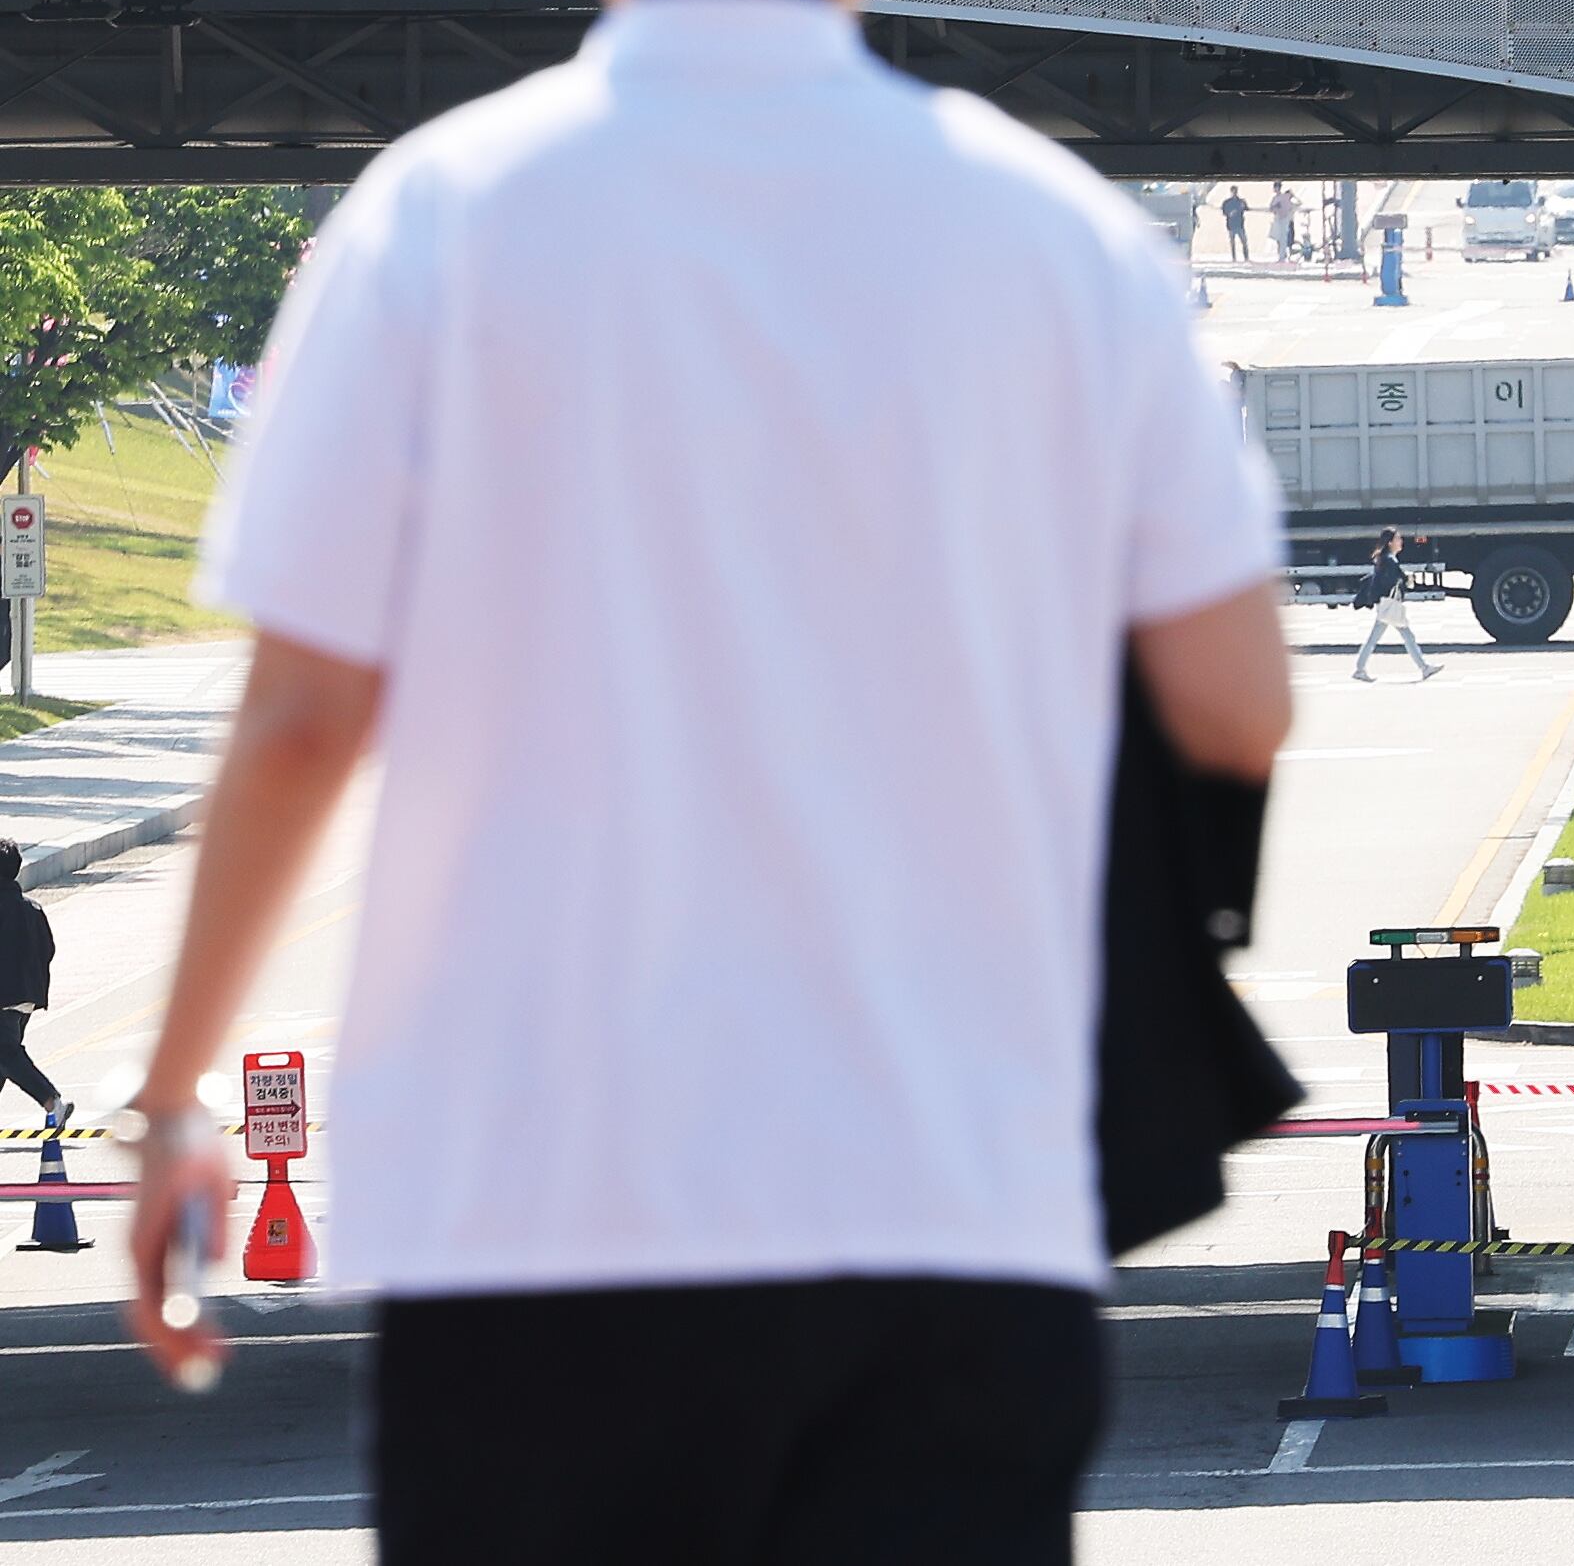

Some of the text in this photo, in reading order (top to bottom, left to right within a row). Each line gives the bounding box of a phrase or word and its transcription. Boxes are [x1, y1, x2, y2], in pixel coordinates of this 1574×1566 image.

[250, 1075, 272, 1087] 차량
[256, 1087, 293, 1100] 검색중!
[252, 1120, 274, 1133] 차선
[264, 1135, 290, 1146] 주의!
